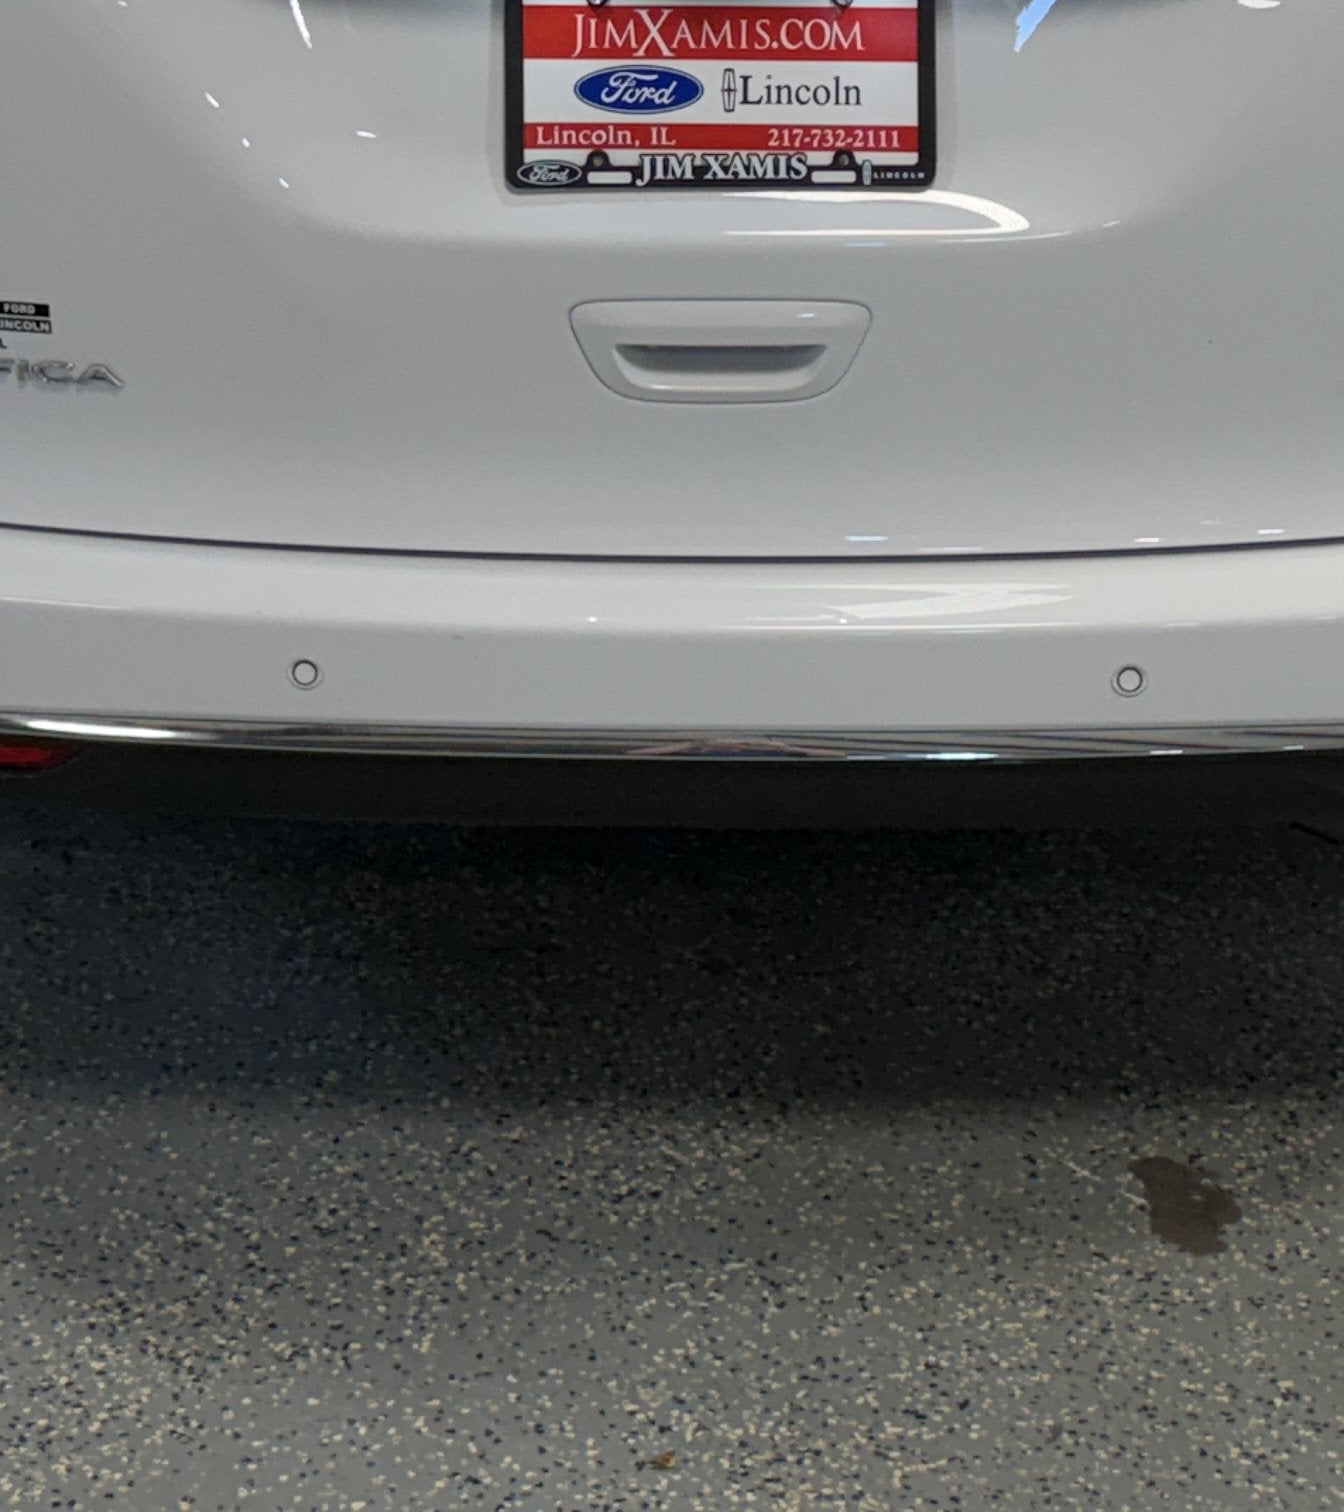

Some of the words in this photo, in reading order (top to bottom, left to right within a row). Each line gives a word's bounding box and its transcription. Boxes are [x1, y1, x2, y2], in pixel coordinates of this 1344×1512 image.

[571, 9, 866, 58] JIMXAMIS.COM
[601, 72, 676, 105] Ford
[740, 75, 862, 105] Lincoln
[536, 126, 641, 147] Lincoln,
[651, 127, 676, 145] IL
[767, 129, 900, 147] 217-732-2111
[635, 153, 696, 186] JIM
[703, 152, 808, 180] XAMIS
[3, 303, 36, 314] FORD
